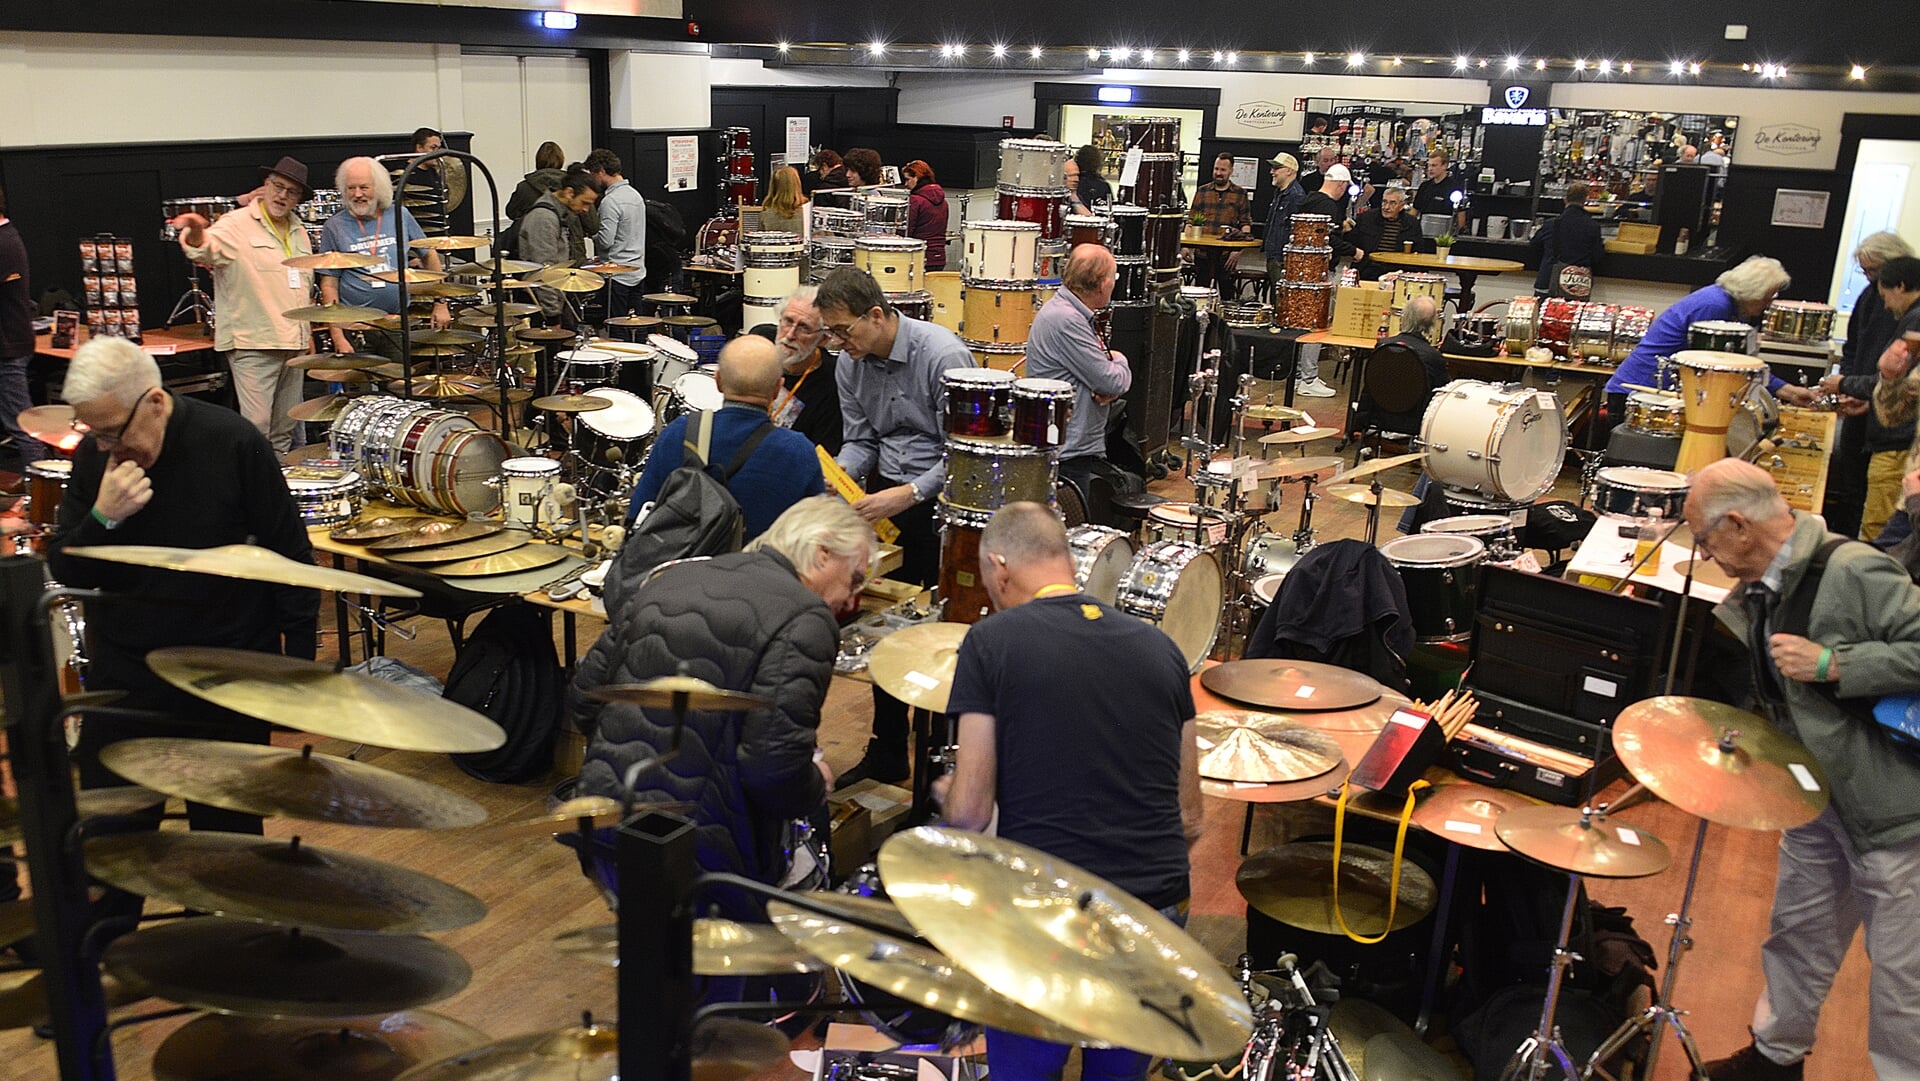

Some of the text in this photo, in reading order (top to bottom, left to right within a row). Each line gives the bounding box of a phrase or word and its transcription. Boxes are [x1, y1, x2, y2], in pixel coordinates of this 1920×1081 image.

[1235, 107, 1287, 121] De Kentering
[349, 237, 397, 252] DRUMMER
